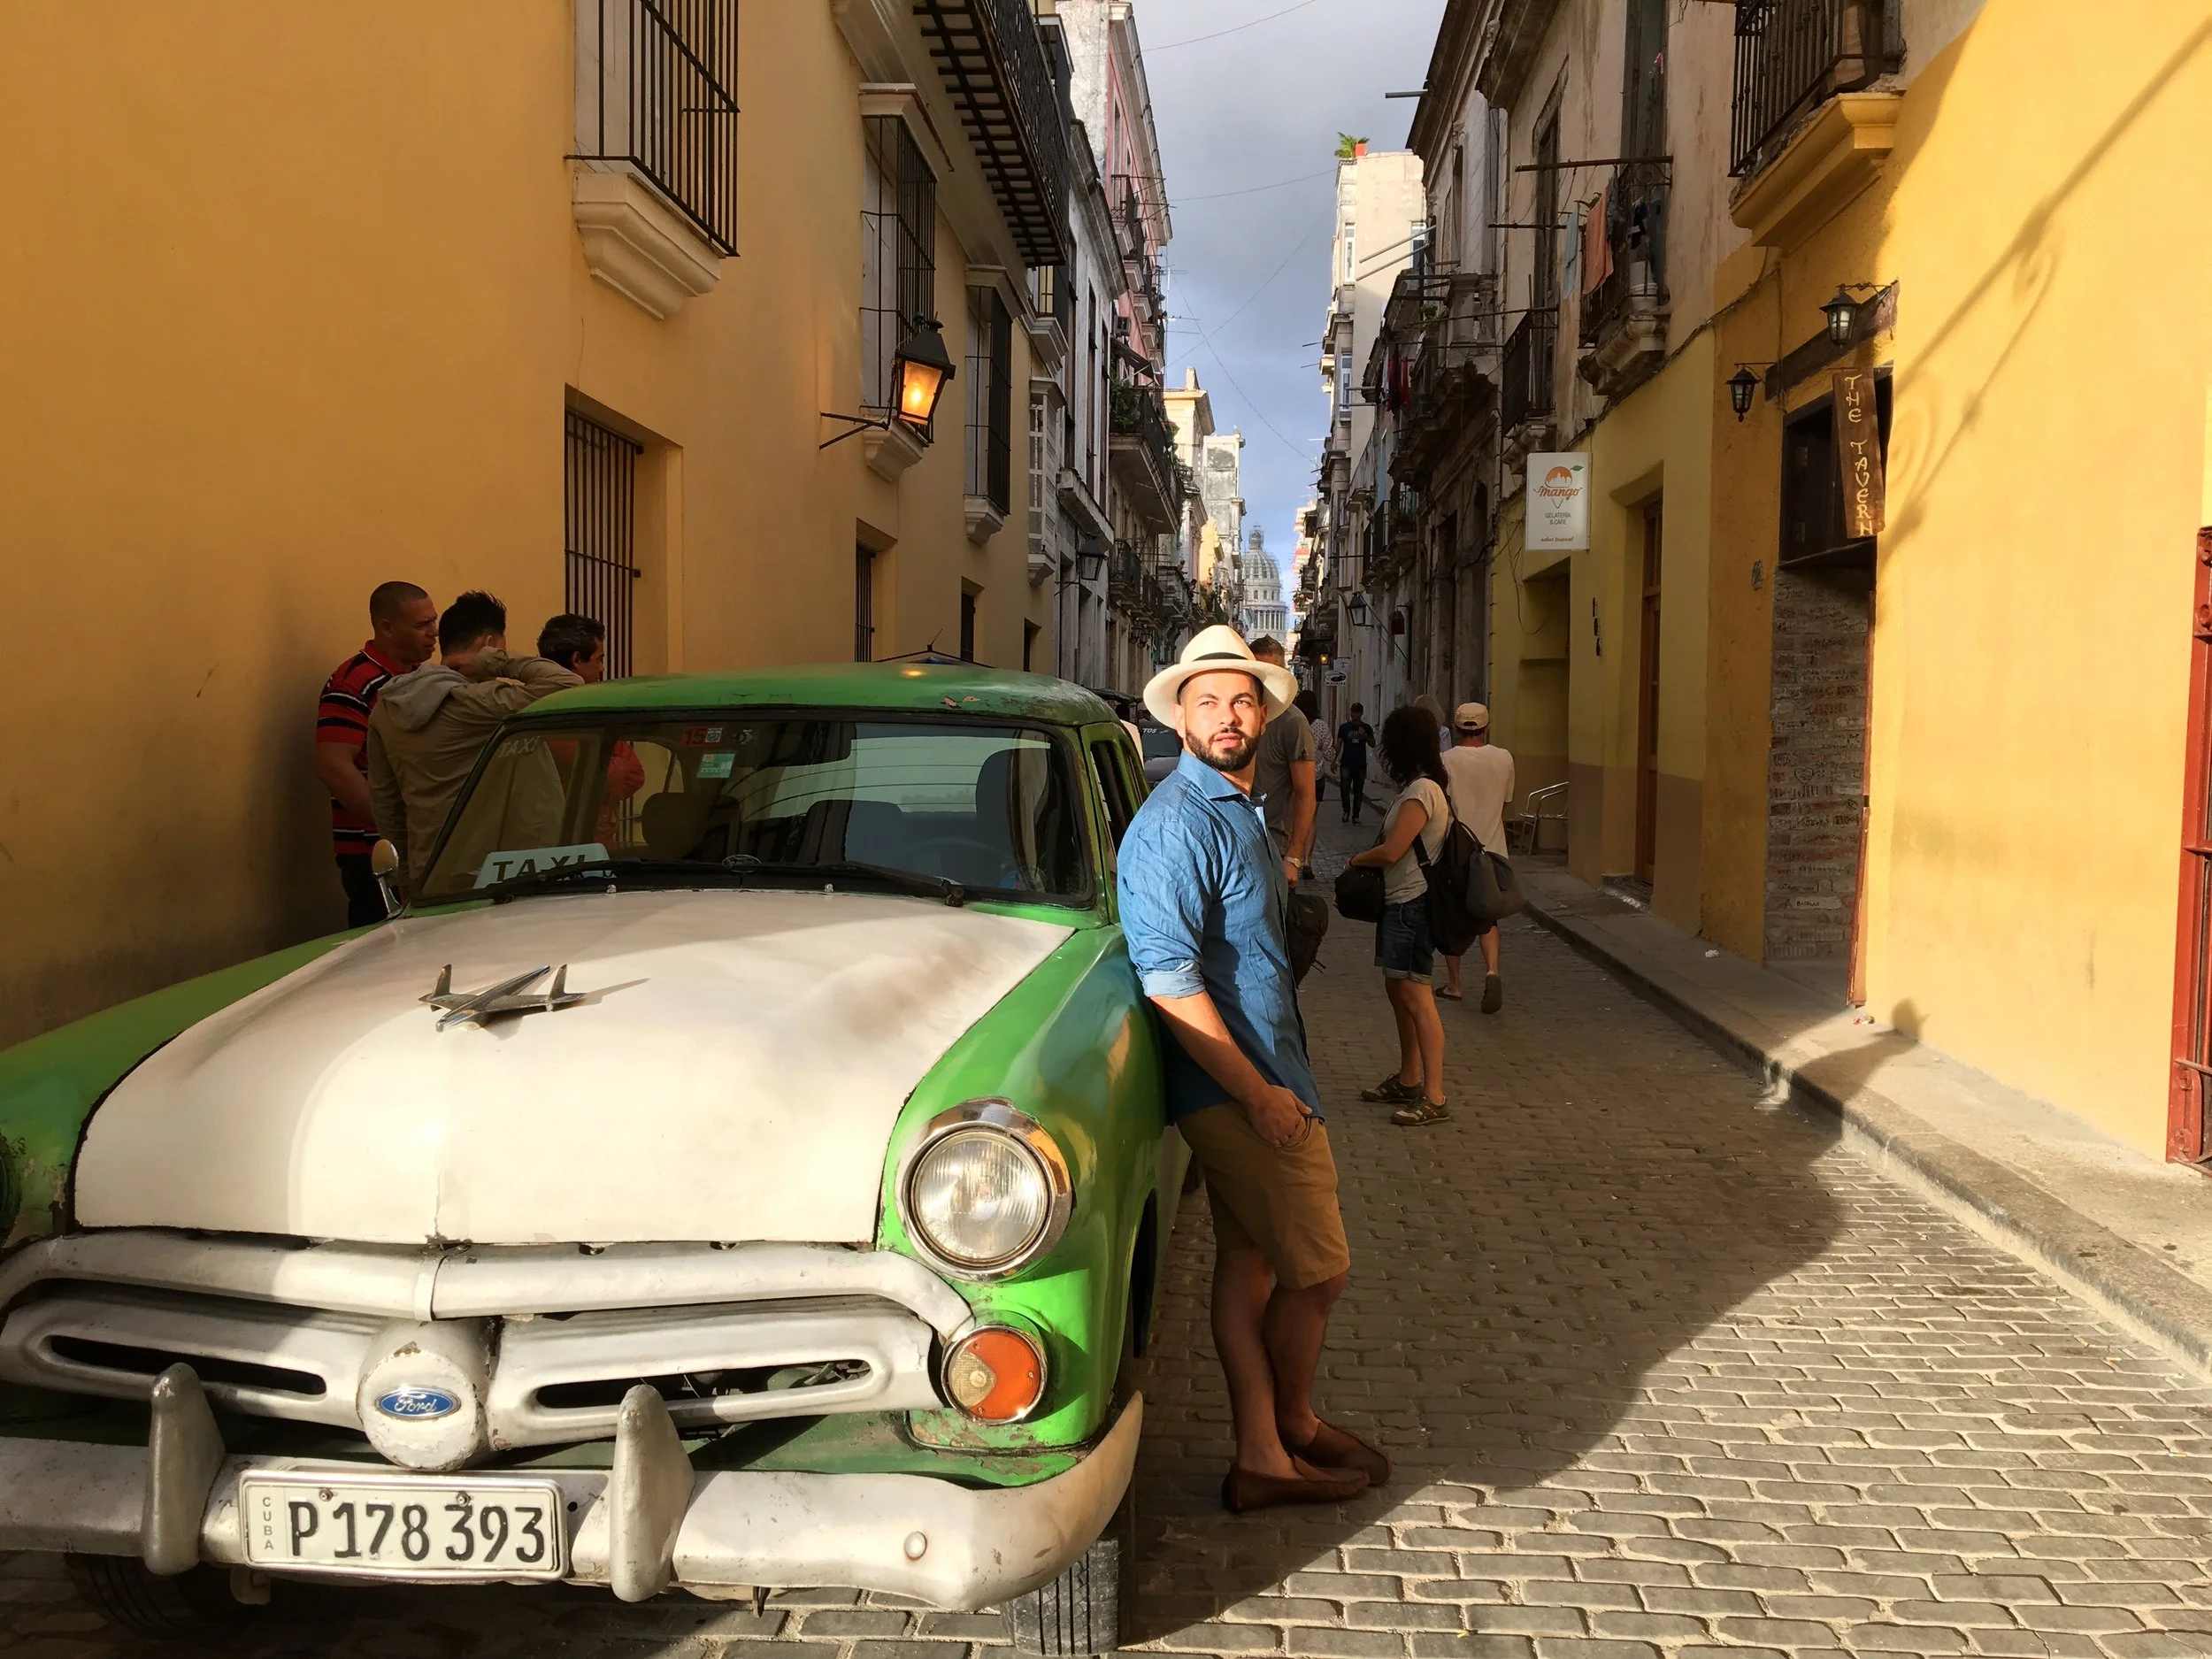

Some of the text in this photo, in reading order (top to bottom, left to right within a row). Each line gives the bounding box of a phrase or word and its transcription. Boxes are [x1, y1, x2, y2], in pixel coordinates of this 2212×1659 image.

[1845, 374, 1873, 536] THE TAVERN
[394, 1393, 438, 1413] Ford
[262, 1496, 274, 1551] CUBA
[444, 1503, 545, 1563] 393
